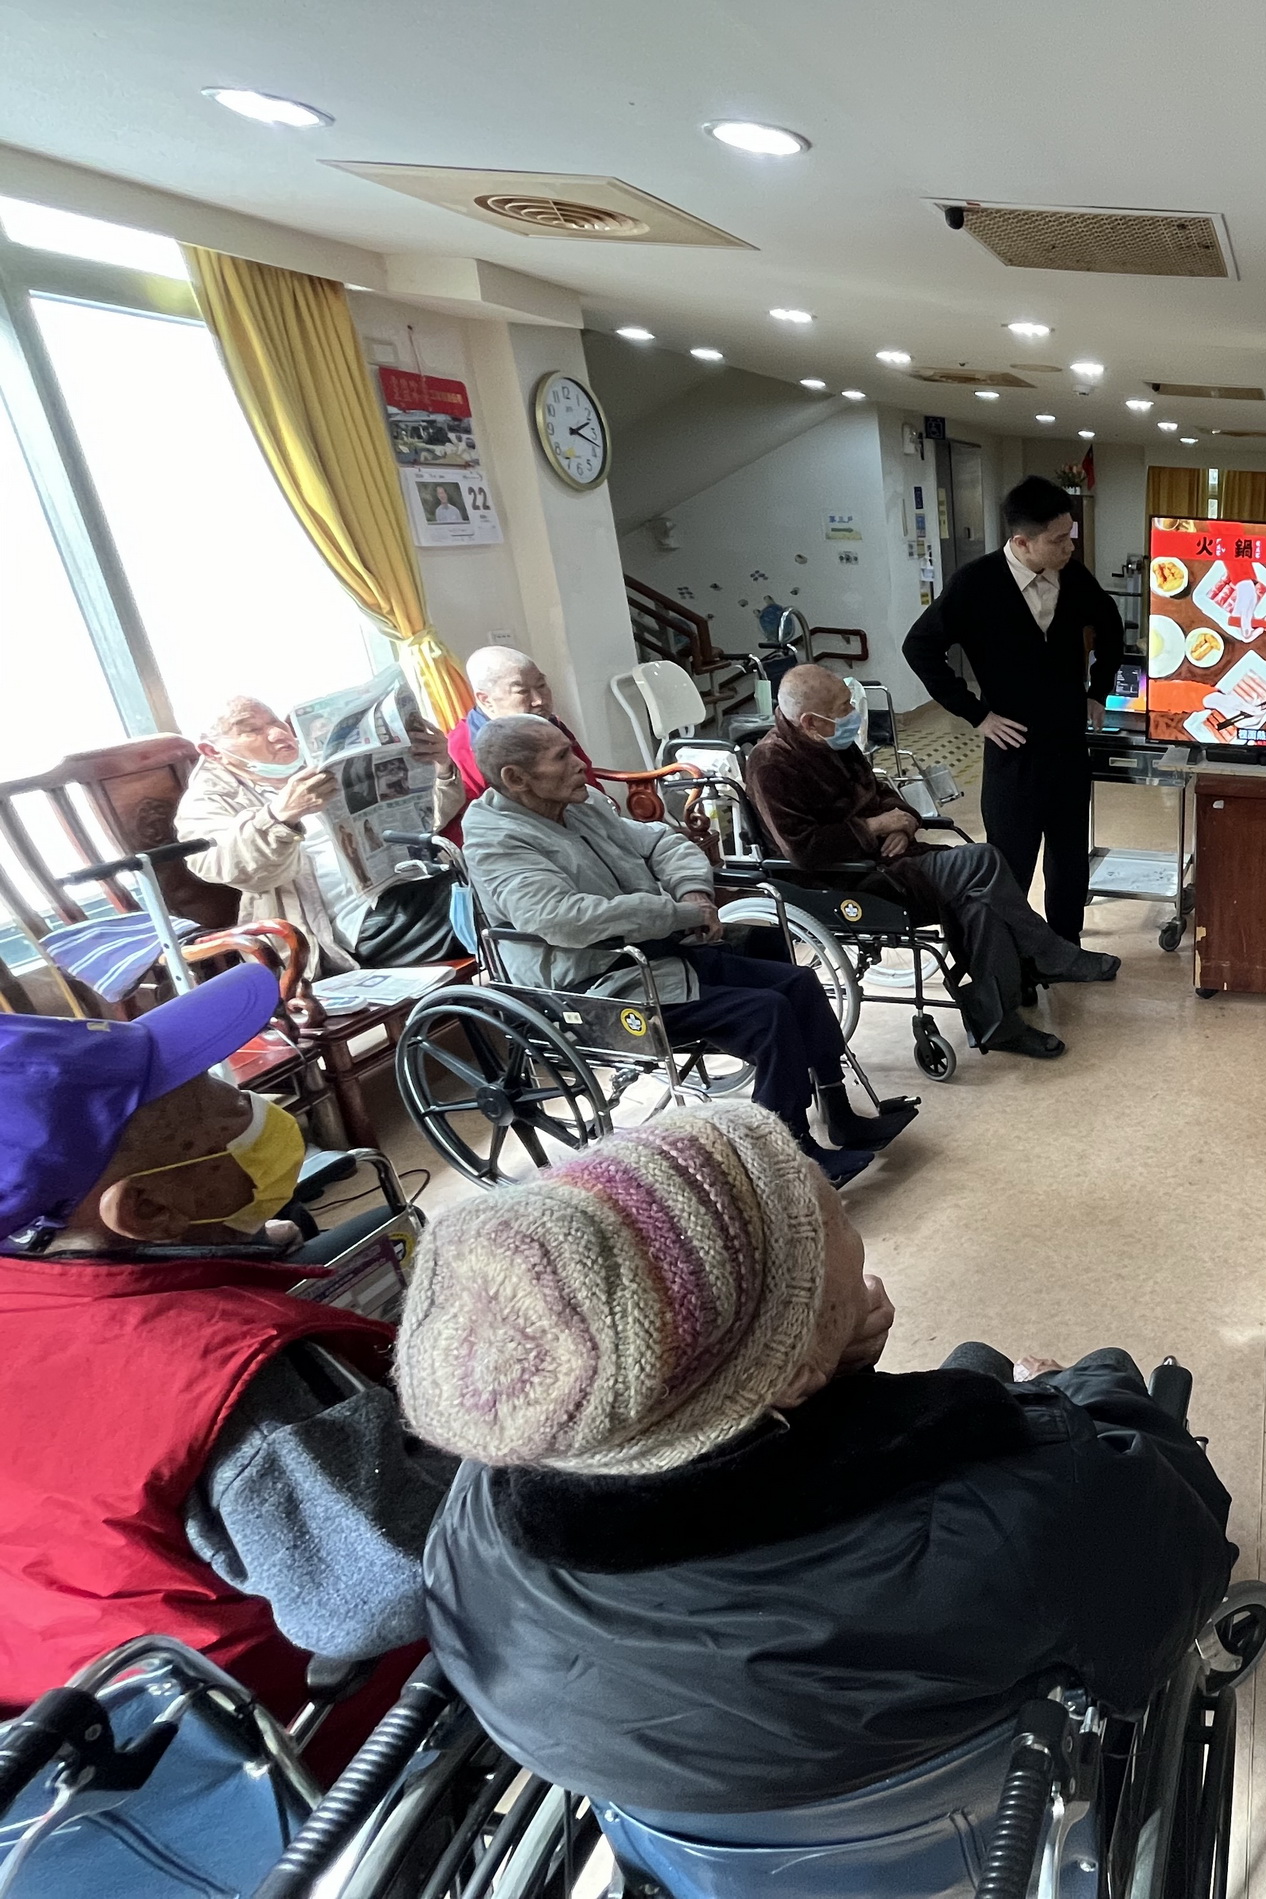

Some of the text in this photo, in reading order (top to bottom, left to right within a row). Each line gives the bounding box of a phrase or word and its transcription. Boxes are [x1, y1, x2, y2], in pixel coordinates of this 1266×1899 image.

[552, 390, 560, 403] 11
[562, 386, 571, 400] 12
[546, 403, 556, 417] 10
[584, 407, 592, 421] 2
[547, 422, 555, 436] 9
[590, 427, 598, 440] 3
[554, 442, 561, 456] 8
[565, 456, 571, 470] 7
[577, 463, 584, 476] 6
[586, 459, 593, 472] 5
[468, 486, 491, 511] 22
